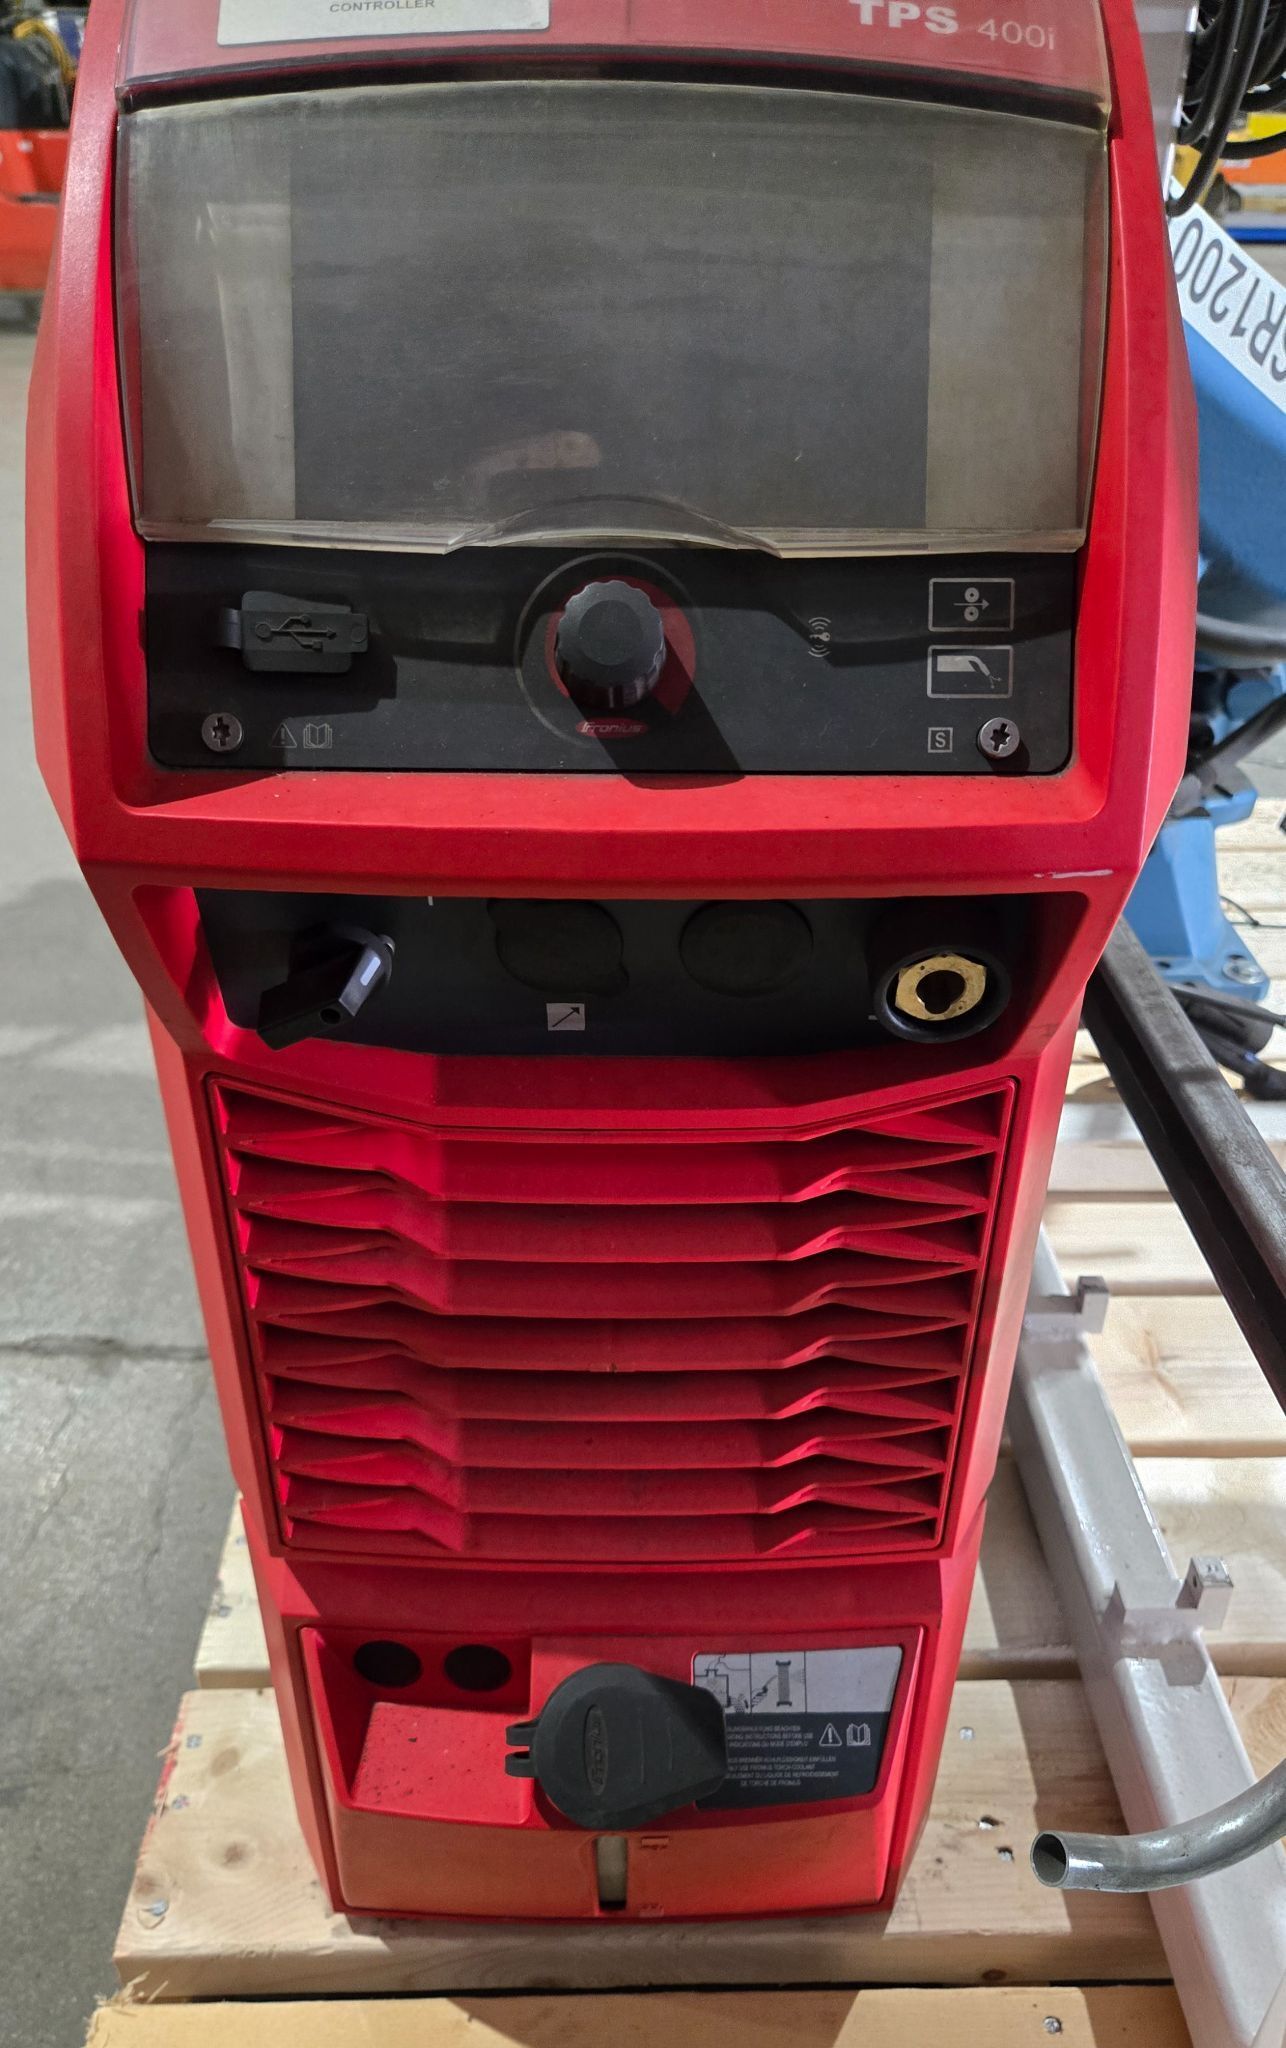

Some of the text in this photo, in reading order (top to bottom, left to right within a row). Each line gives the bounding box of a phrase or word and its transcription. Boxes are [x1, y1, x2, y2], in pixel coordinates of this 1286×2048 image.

[329, 0, 435, 13] CONTROLLER
[848, 0, 1057, 50] TPS 400i
[935, 731, 946, 748] S
